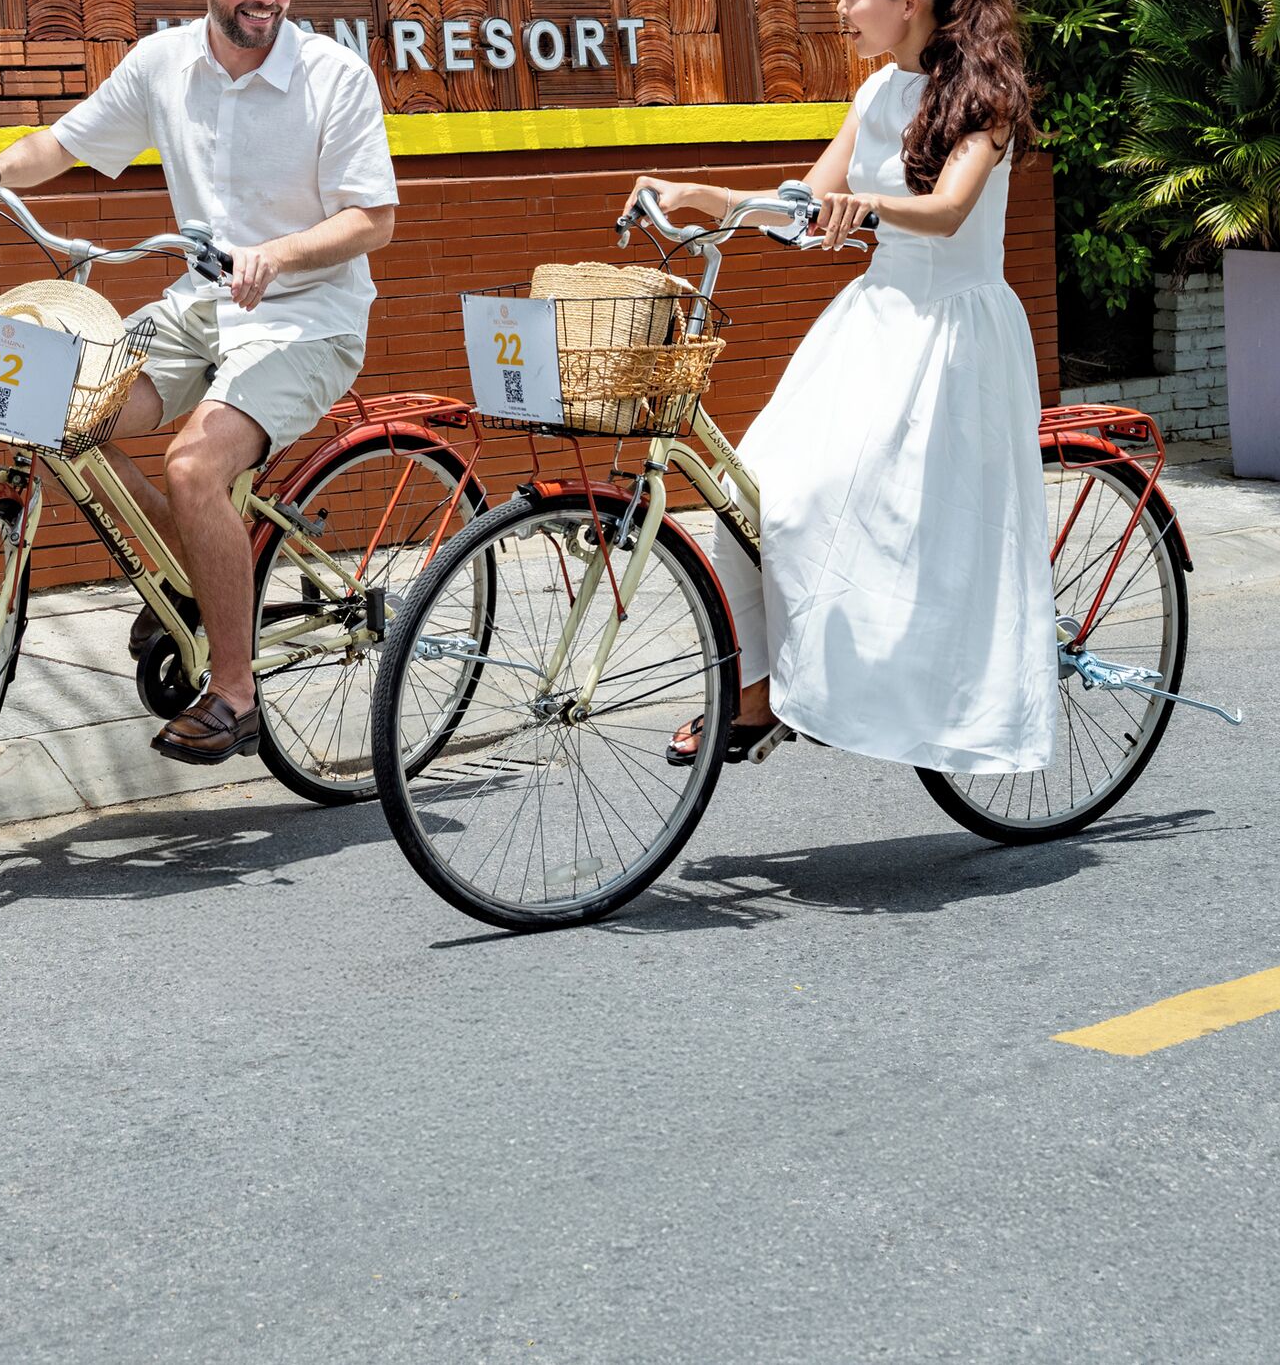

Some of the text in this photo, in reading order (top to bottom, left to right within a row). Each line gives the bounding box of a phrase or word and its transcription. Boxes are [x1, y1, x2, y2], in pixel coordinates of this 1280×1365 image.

[392, 17, 645, 71] RESORT
[494, 332, 524, 366] 22
[89, 502, 141, 571] ASAMA
[729, 510, 761, 553] ASA
